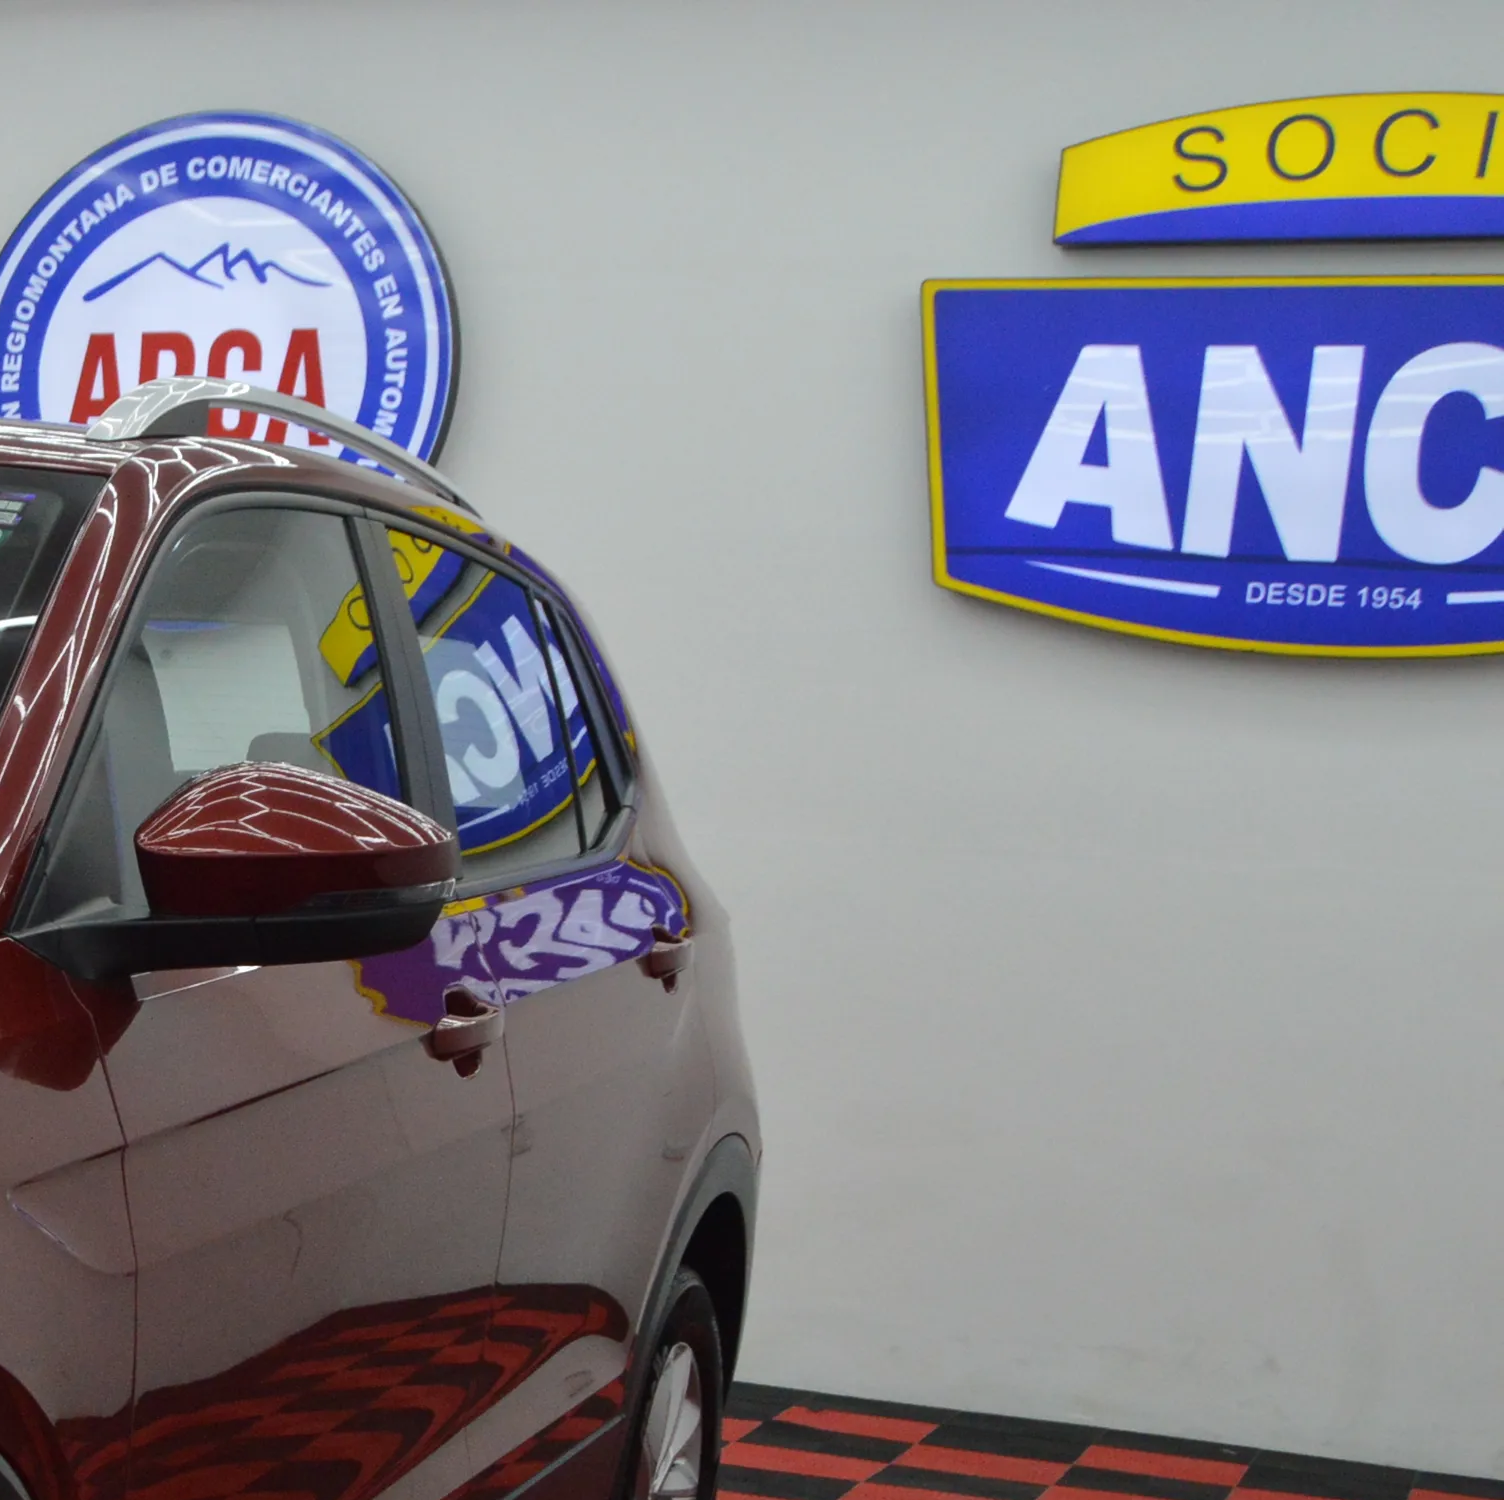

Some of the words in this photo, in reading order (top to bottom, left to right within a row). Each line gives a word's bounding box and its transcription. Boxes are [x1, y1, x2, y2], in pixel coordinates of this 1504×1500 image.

[1, 183, 134, 393] REGIOMONTANA
[141, 161, 179, 193] DE
[186, 155, 386, 274] COMERCIANTES
[373, 273, 404, 318] EN
[1245, 581, 1346, 608] DESDE
[1356, 584, 1423, 610] 1954
